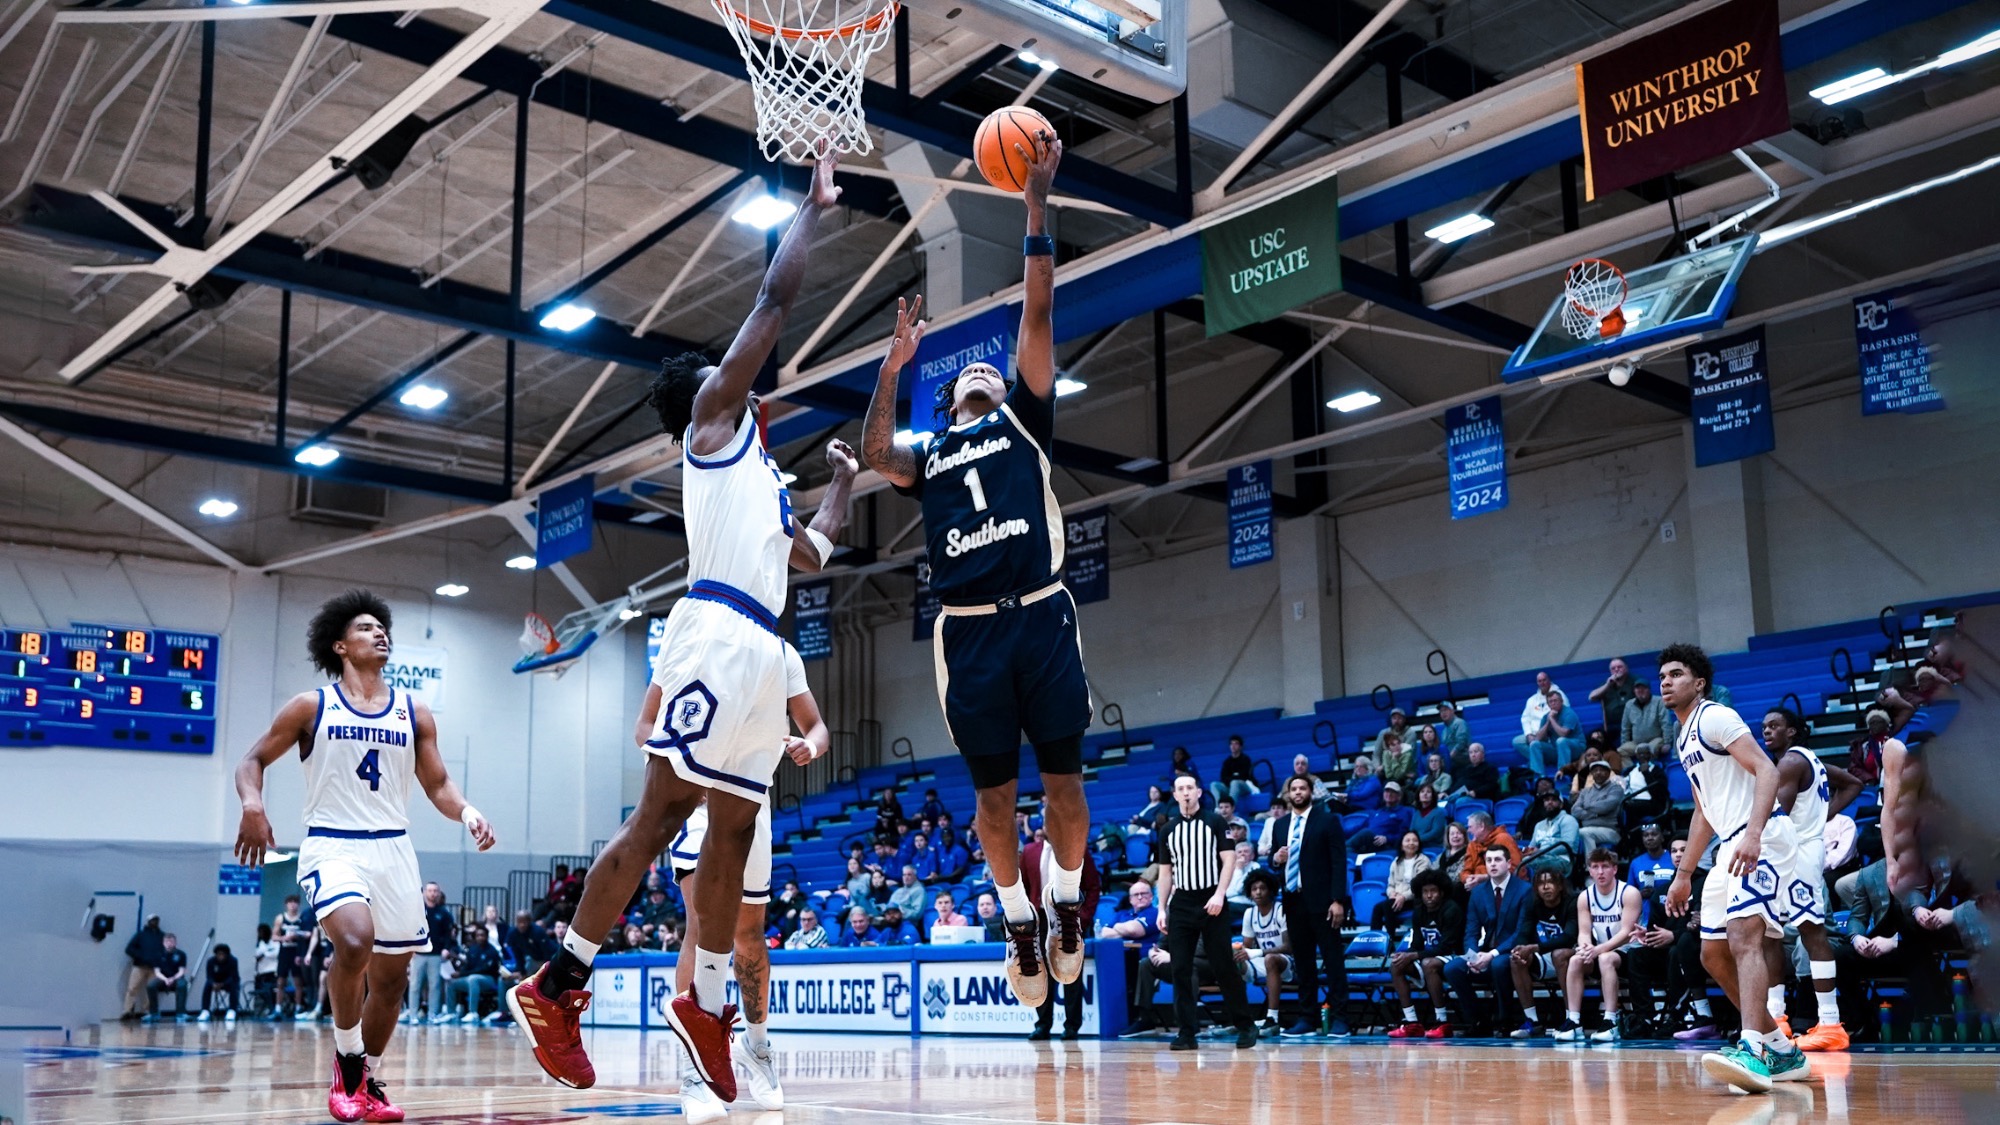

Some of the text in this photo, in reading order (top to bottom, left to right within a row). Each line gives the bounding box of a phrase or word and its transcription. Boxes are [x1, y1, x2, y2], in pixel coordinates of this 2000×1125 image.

[1610, 41, 1751, 115] WINTHROP
[1605, 69, 1761, 148] UNIVERSITY
[1250, 228, 1286, 258] USC
[1230, 246, 1309, 294] UPSTATE
[921, 335, 1003, 381] PRESBYTERIAN
[1694, 372, 1763, 396] BASKETBALL
[1450, 425, 1500, 446] BASKETBALL
[925, 436, 1011, 479] Charleston
[1464, 458, 1487, 470] NCAA
[1452, 461, 1504, 481] TOURNAMENT
[963, 467, 988, 512] 1
[1457, 486, 1502, 511] 2024
[946, 516, 1029, 558] Southern
[1233, 523, 1269, 544] 2024
[20, 632, 41, 655] 18
[125, 631, 146, 653] 18
[165, 634, 210, 649] VISITOR
[75, 650, 97, 673] 18
[183, 648, 203, 670] 14
[382, 662, 443, 680] GAME
[25, 687, 38, 707] 3
[129, 685, 143, 705] 3
[190, 690, 203, 711] 5
[80, 699, 94, 718] 3
[327, 725, 407, 748] PRESBYTERIAN
[356, 748, 383, 791] 4
[795, 978, 876, 1015] COLLEGE
[882, 972, 911, 1019] PC
[953, 1011, 1035, 1022] CONSTRUCTION
